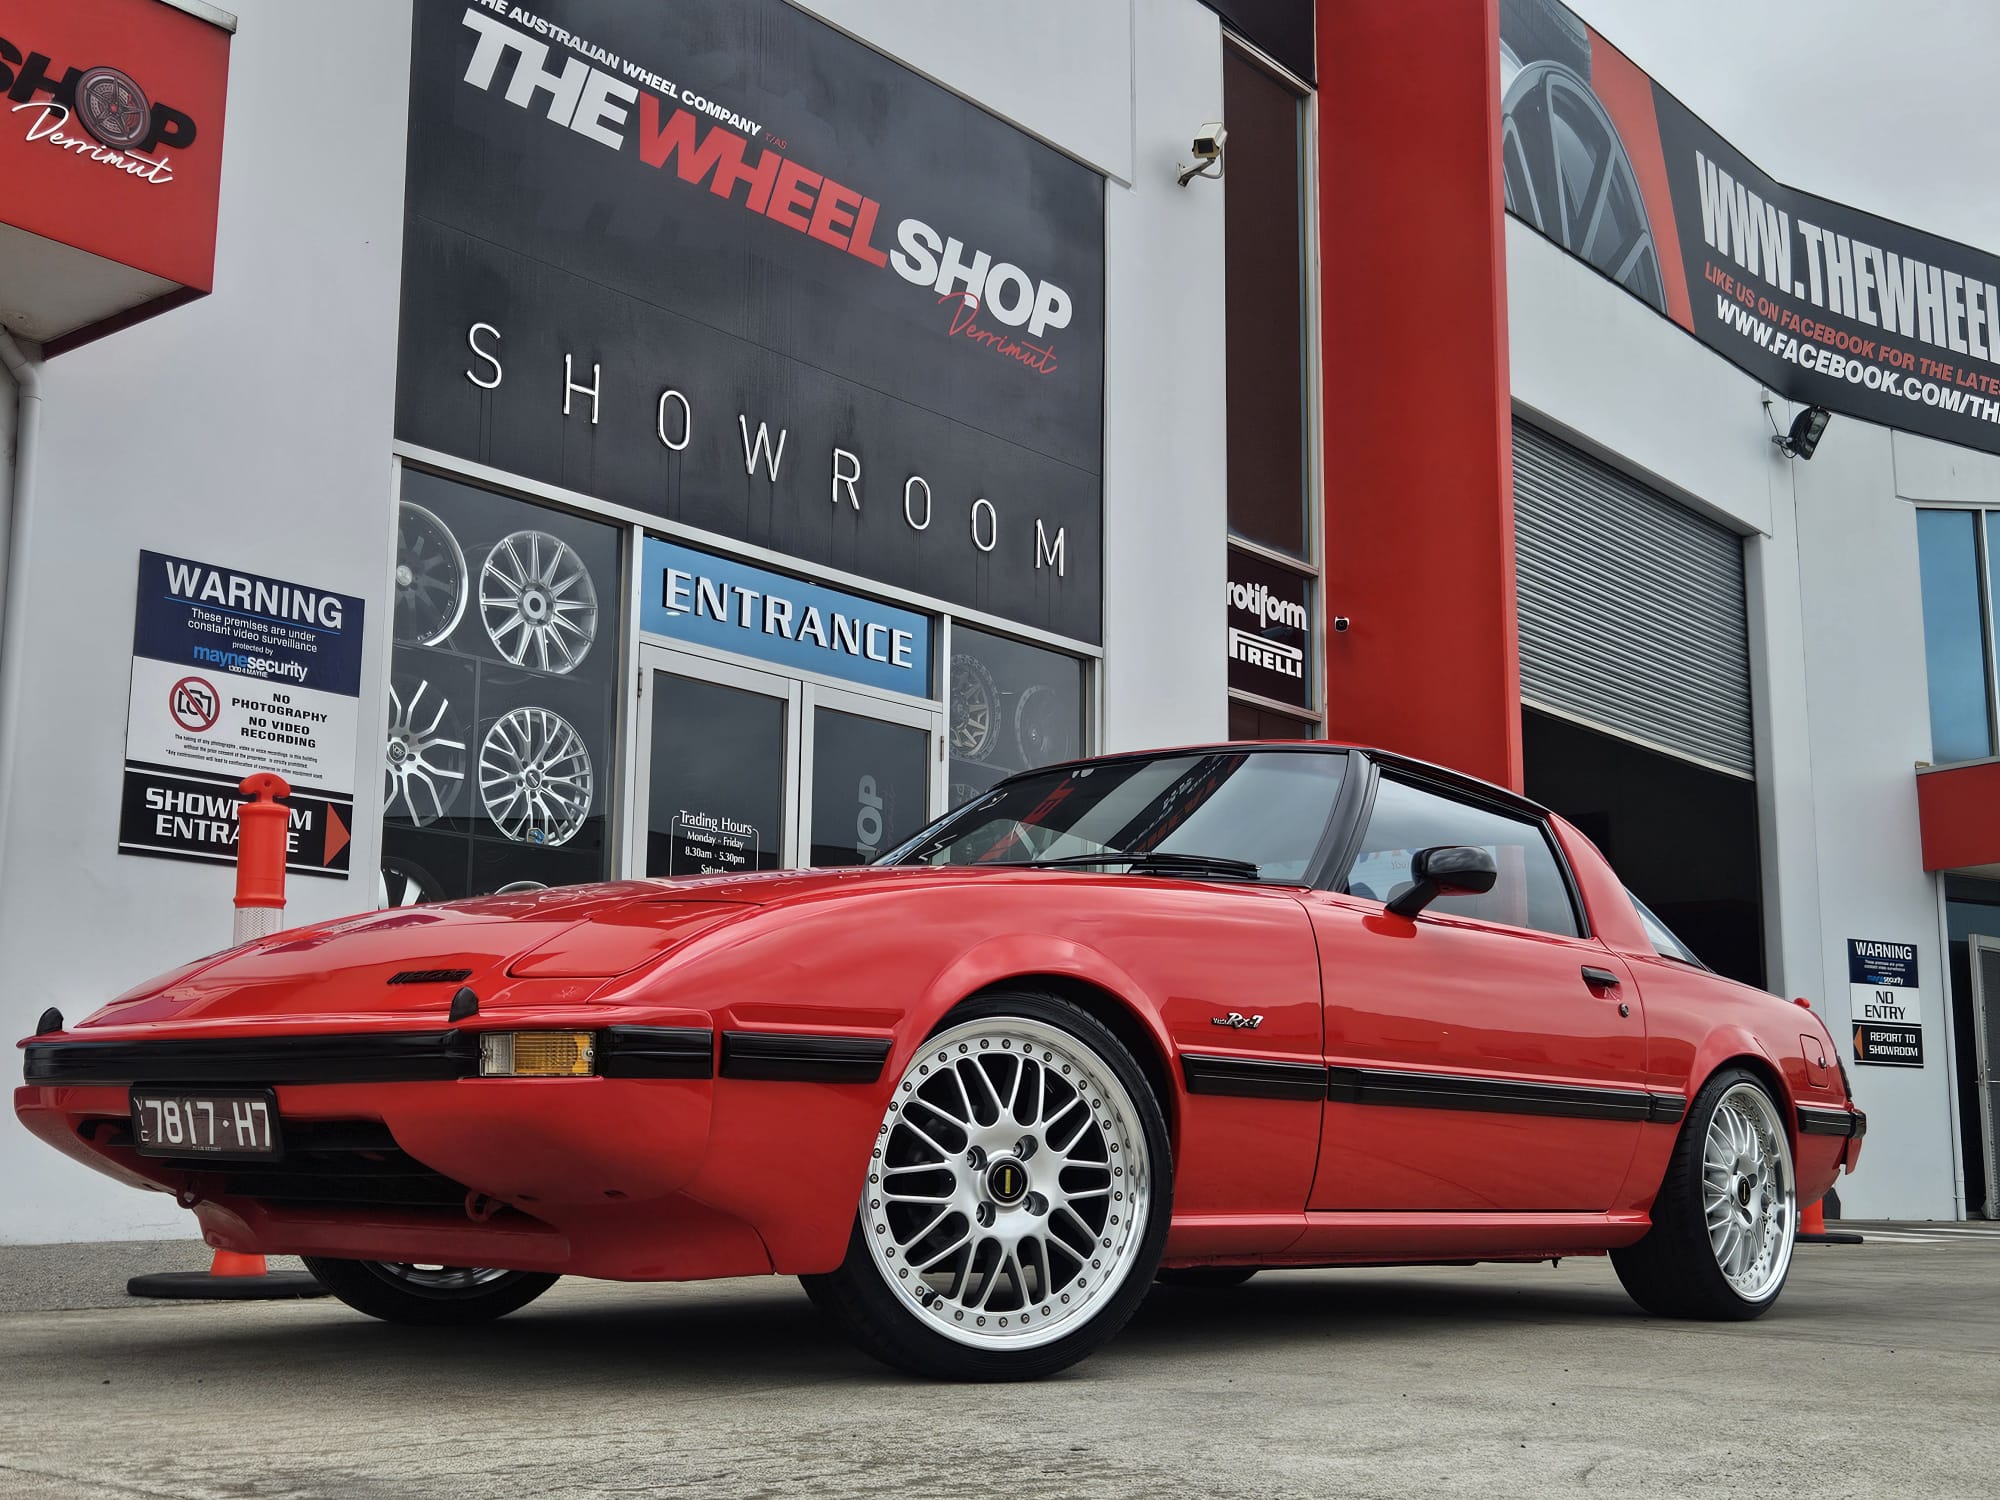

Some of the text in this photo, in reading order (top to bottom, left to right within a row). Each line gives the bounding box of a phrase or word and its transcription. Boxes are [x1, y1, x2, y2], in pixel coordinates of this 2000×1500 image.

[474, 0, 508, 14] HE
[508, 6, 620, 69] AUSTRALIAN
[622, 59, 679, 99] WHEEL
[681, 89, 762, 136] COMPANY
[12, 102, 173, 183] Derrimut
[461, 7, 1073, 338] THE WHEEL SHOP
[937, 291, 1058, 374] Derrimut
[1704, 260, 2000, 396] LIKE US ON FACEBOOK FOR THE LATE
[1716, 293, 2000, 425] WWW.FACEBOOK.COM/TH
[465, 322, 1066, 577] SHOWROOM
[165, 560, 344, 629] WARNING
[1227, 581, 1309, 631] rotiform
[191, 607, 316, 642] These premises are under
[663, 567, 913, 669] ENTRANCE
[187, 620, 318, 653] constant video surveillance
[232, 641, 274, 656] protected by
[1228, 626, 1303, 679] PIRELLI
[231, 697, 328, 723] PHOTOGRAPHY
[272, 693, 290, 704] NO
[240, 727, 316, 748] RECORDING
[248, 716, 310, 735] NO VIDEO
[680, 809, 752, 835] Trading Hours
[686, 830, 716, 846] Monday
[723, 836, 744, 851] Friday
[685, 846, 712, 859] 8.30am
[719, 851, 745, 866] 5.30pm
[1855, 941, 1912, 960] WARNING
[1875, 990, 1894, 1004] NO
[1864, 1004, 1906, 1020] ENTRY
[1869, 1044, 1918, 1057] SHOWROOM
[1870, 1031, 1916, 1044] REPORT TO
